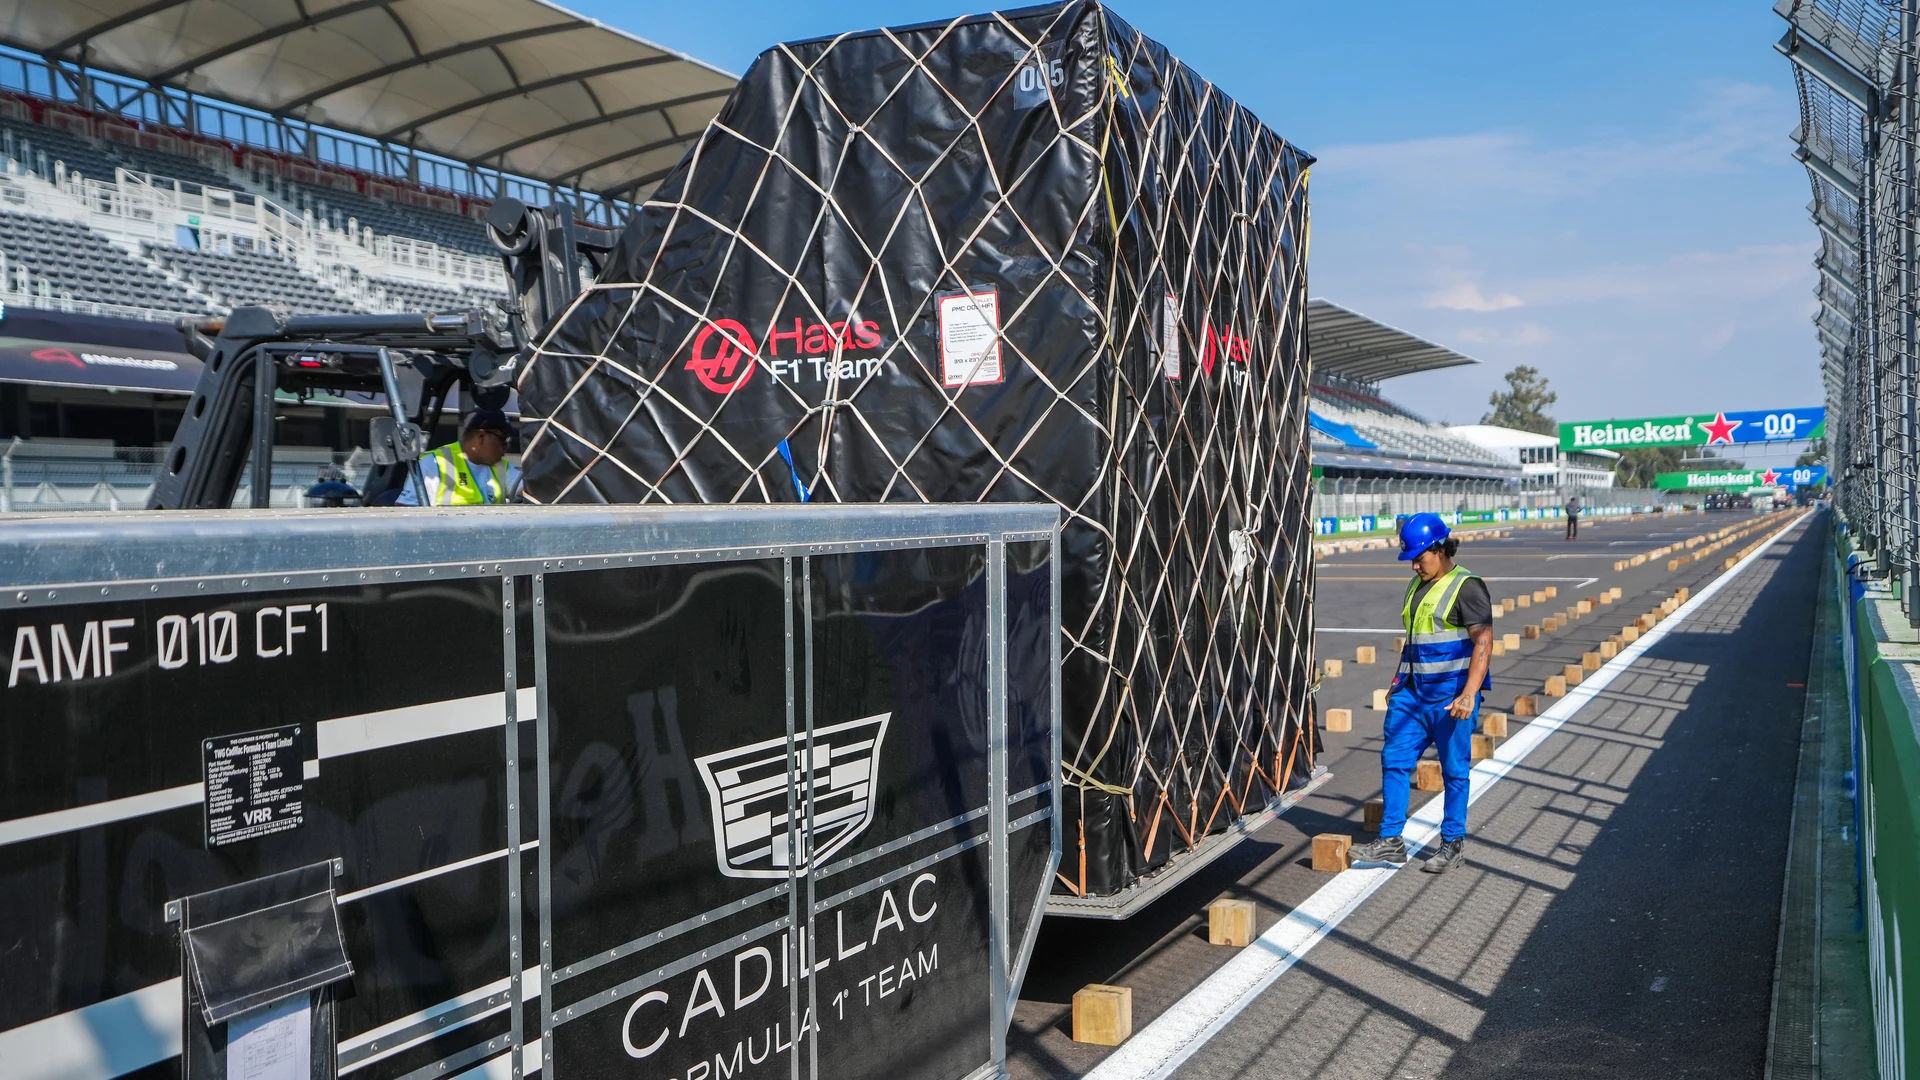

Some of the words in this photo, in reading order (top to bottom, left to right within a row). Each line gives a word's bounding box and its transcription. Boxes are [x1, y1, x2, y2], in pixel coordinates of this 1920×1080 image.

[1020, 58, 1064, 92] 005
[769, 317, 881, 356] Haas
[807, 357, 883, 382] Team
[8, 618, 135, 688] AMF
[156, 610, 238, 670] 010
[256, 602, 328, 658] CF1
[214, 748, 225, 759] TWG
[225, 745, 242, 757] Cadillac
[243, 742, 261, 754] Formula
[265, 739, 276, 750] Team
[276, 736, 292, 748] Limited
[223, 767, 248, 778] Manufacturing
[242, 806, 271, 826] VRR
[622, 872, 938, 1060] CADILLAC
[858, 943, 939, 1006] TEAM
